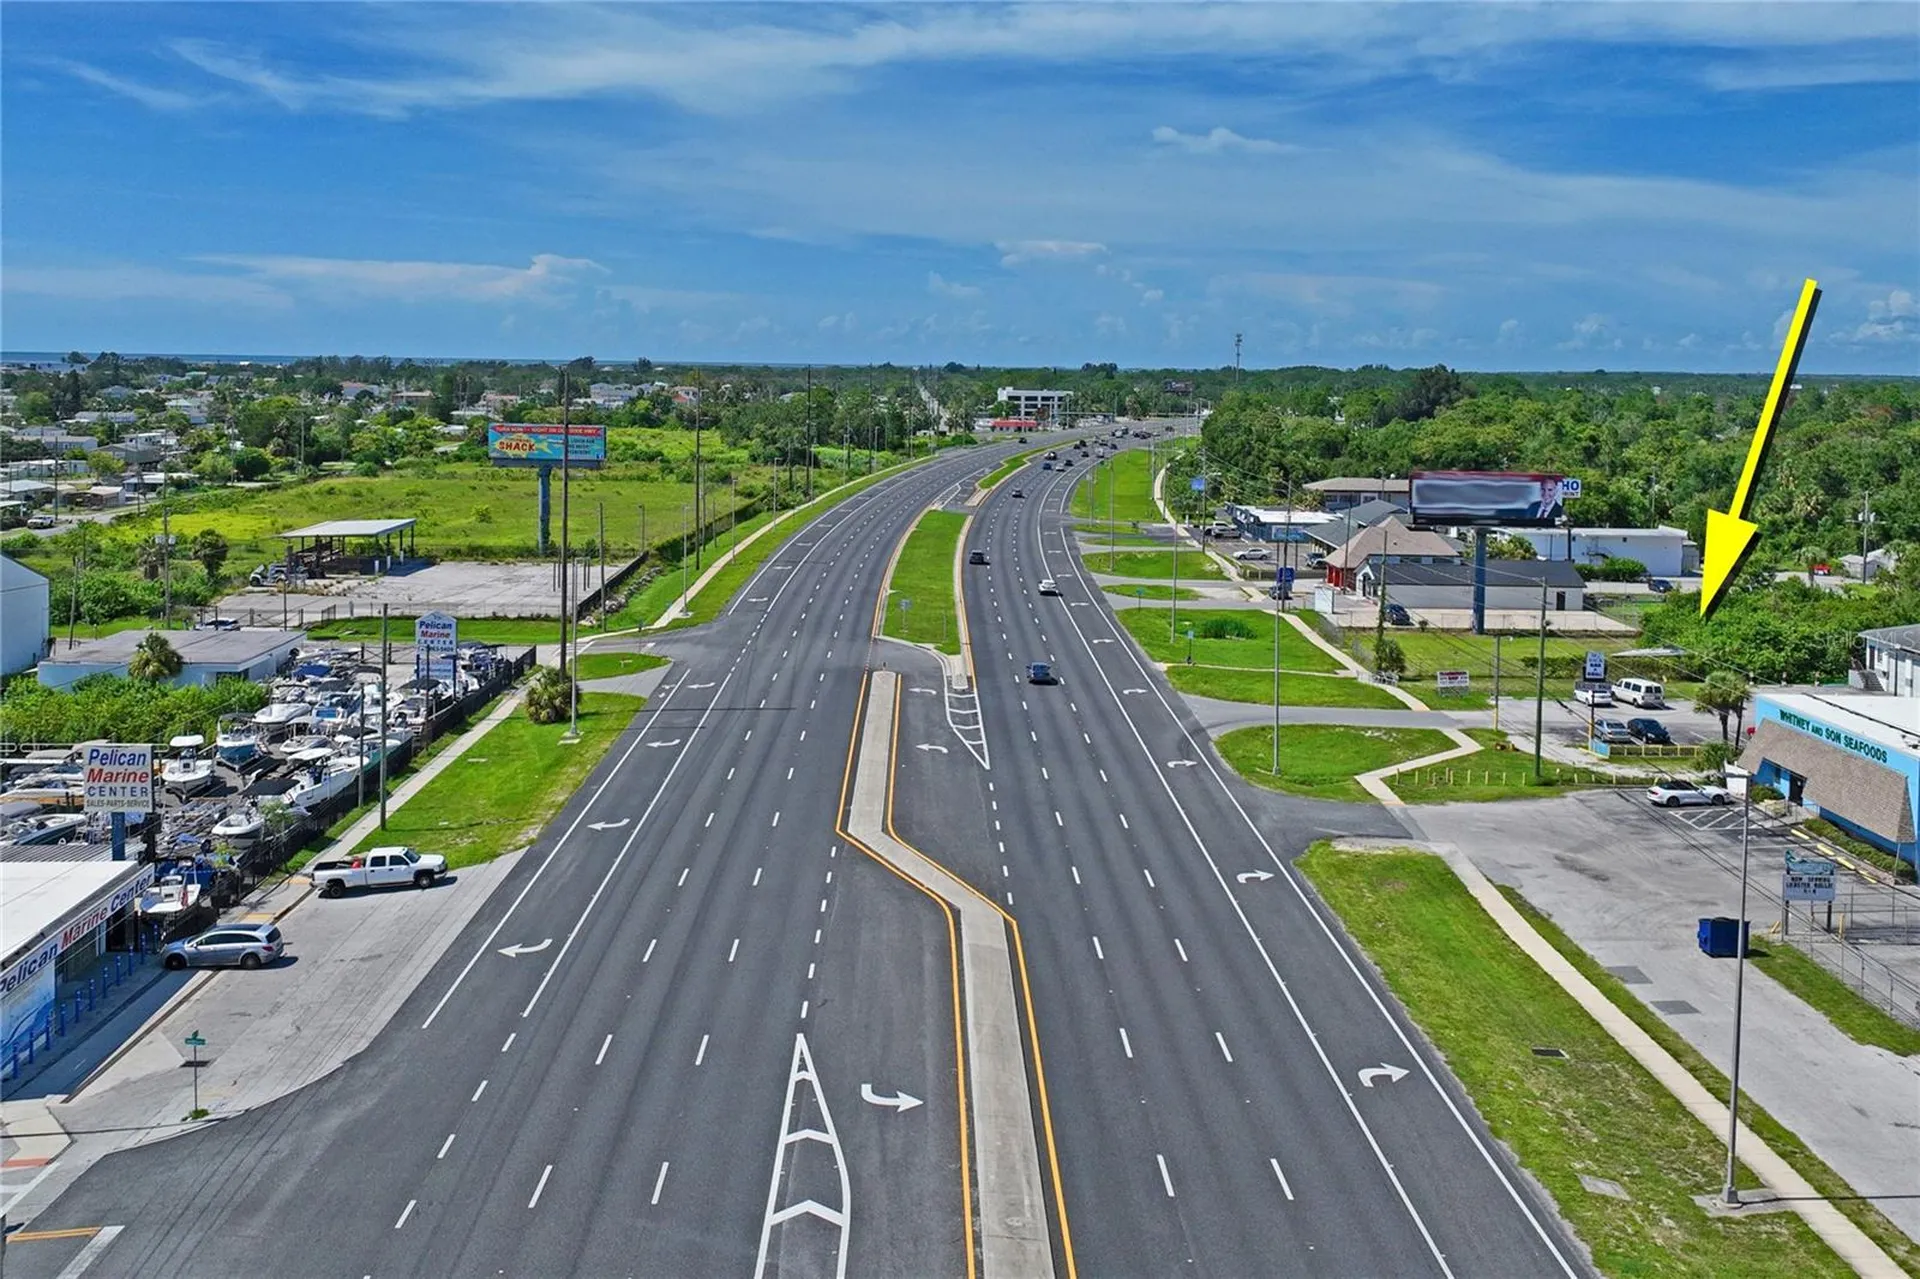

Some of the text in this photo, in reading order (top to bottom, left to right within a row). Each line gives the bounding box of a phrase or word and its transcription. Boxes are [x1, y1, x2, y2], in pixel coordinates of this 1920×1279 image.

[498, 441, 535, 452] SHACK
[420, 621, 453, 630] Pelican
[421, 630, 451, 639] Marine
[1779, 709, 1888, 763] WHITNEY AND SON SEAFOODS
[89, 748, 146, 766] Pelican
[86, 767, 149, 783] Marine
[87, 786, 149, 797] CENTER
[60, 907, 108, 950] Marine
[110, 873, 153, 912] Center
